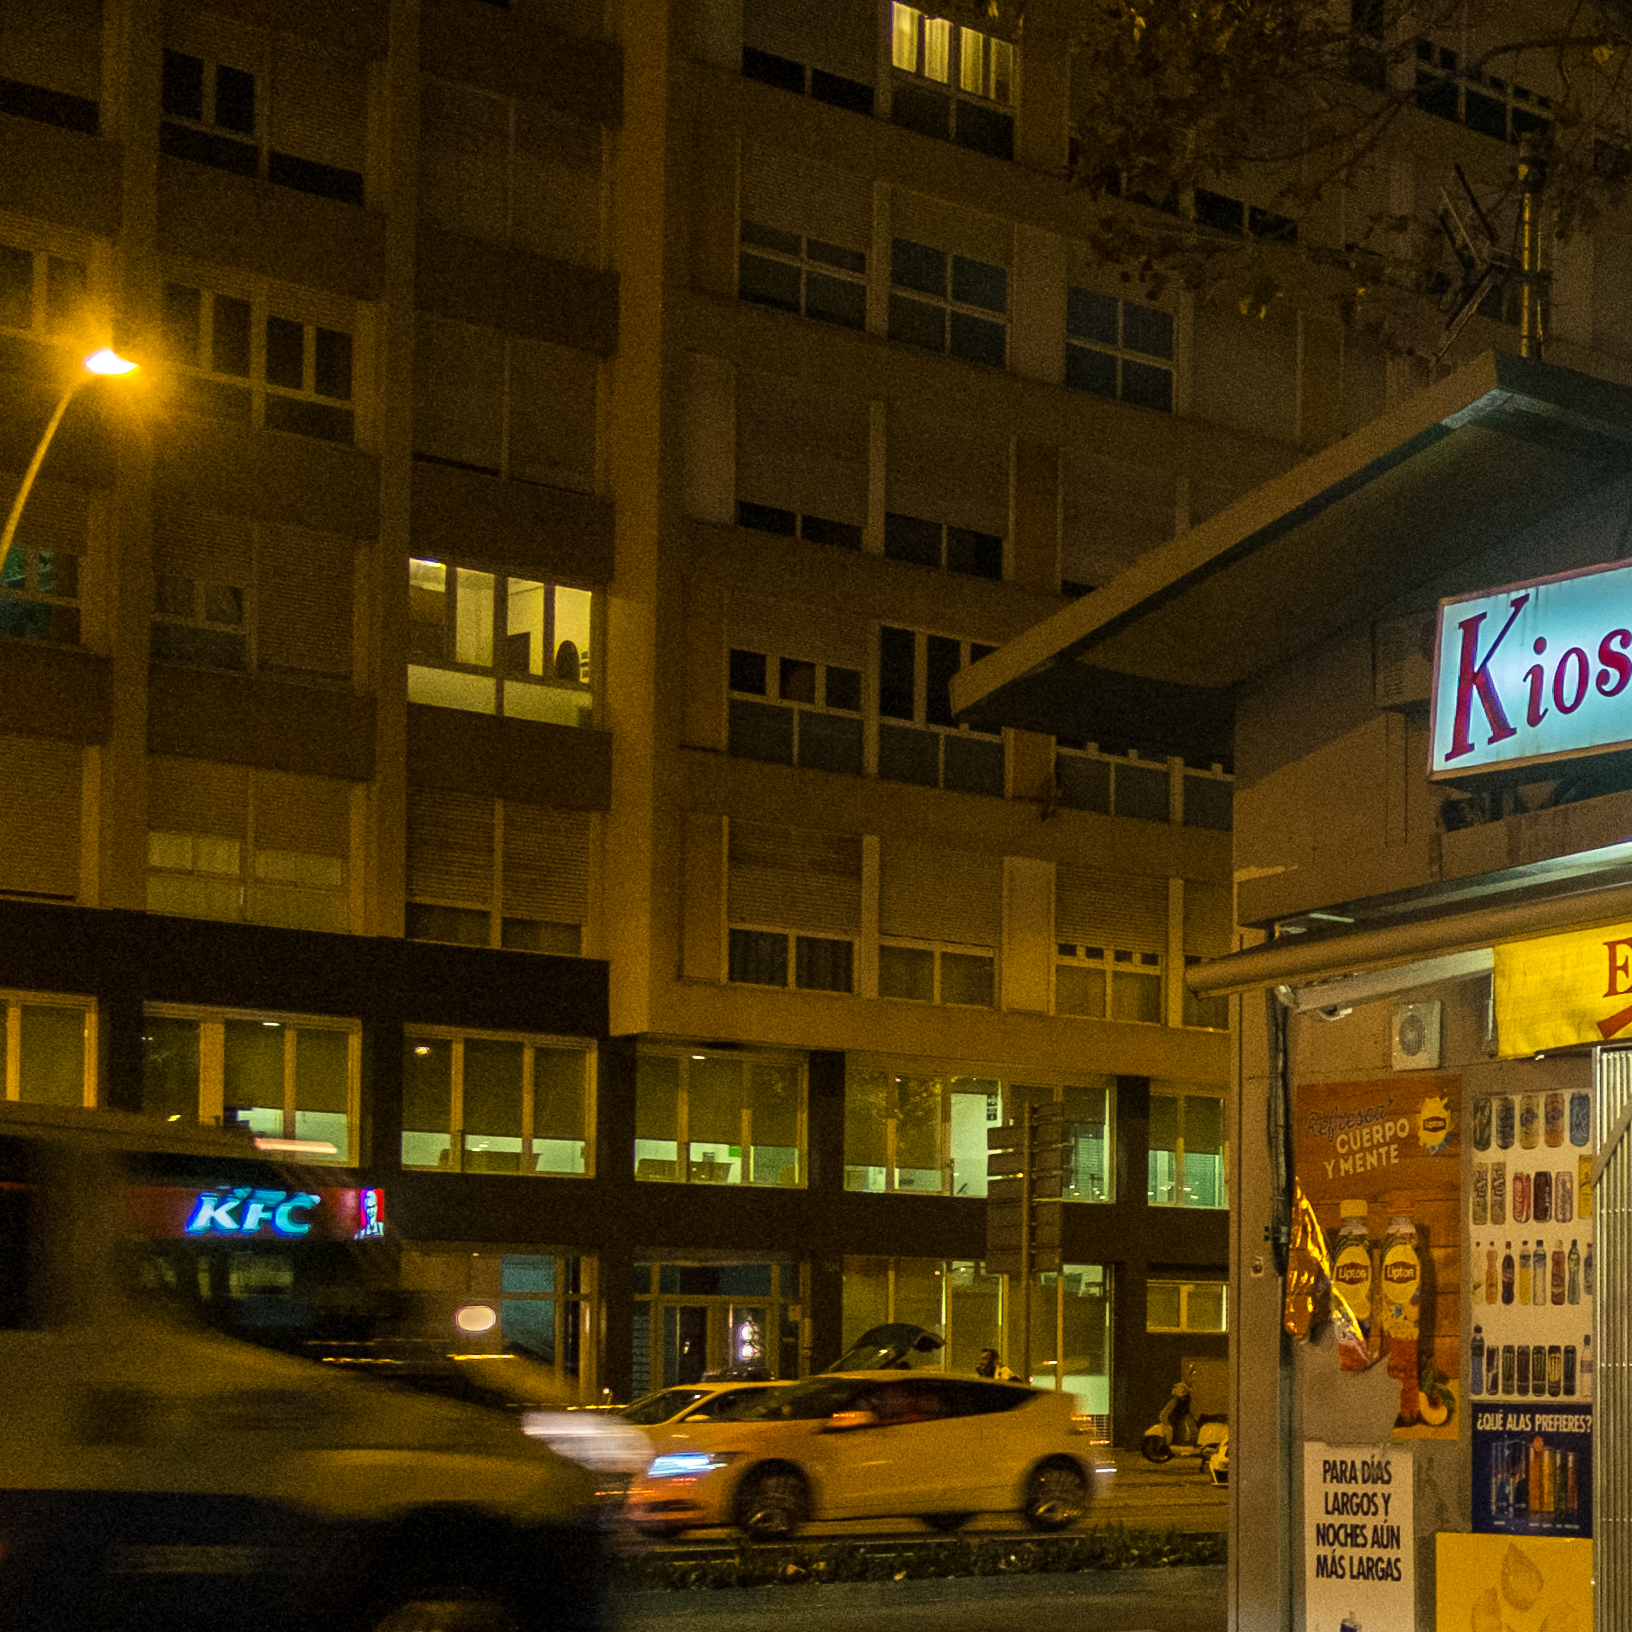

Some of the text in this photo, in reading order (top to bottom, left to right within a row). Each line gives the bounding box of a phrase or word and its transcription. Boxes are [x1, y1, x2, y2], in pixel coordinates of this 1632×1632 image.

[1336, 1118, 1410, 1154] CUERPO
[1323, 1143, 1399, 1179] Y MENTE
[186, 1188, 321, 1236] KFC
[1477, 1408, 1593, 1433] ¿QUÉ ALAS PREFIERES?
[1323, 1454, 1392, 1485] PARA DÍAS
[1324, 1491, 1392, 1517] LARGOS Y
[1316, 1518, 1401, 1550] NOCHES AÚN
[1316, 1548, 1402, 1582] MÁS LARGAS
